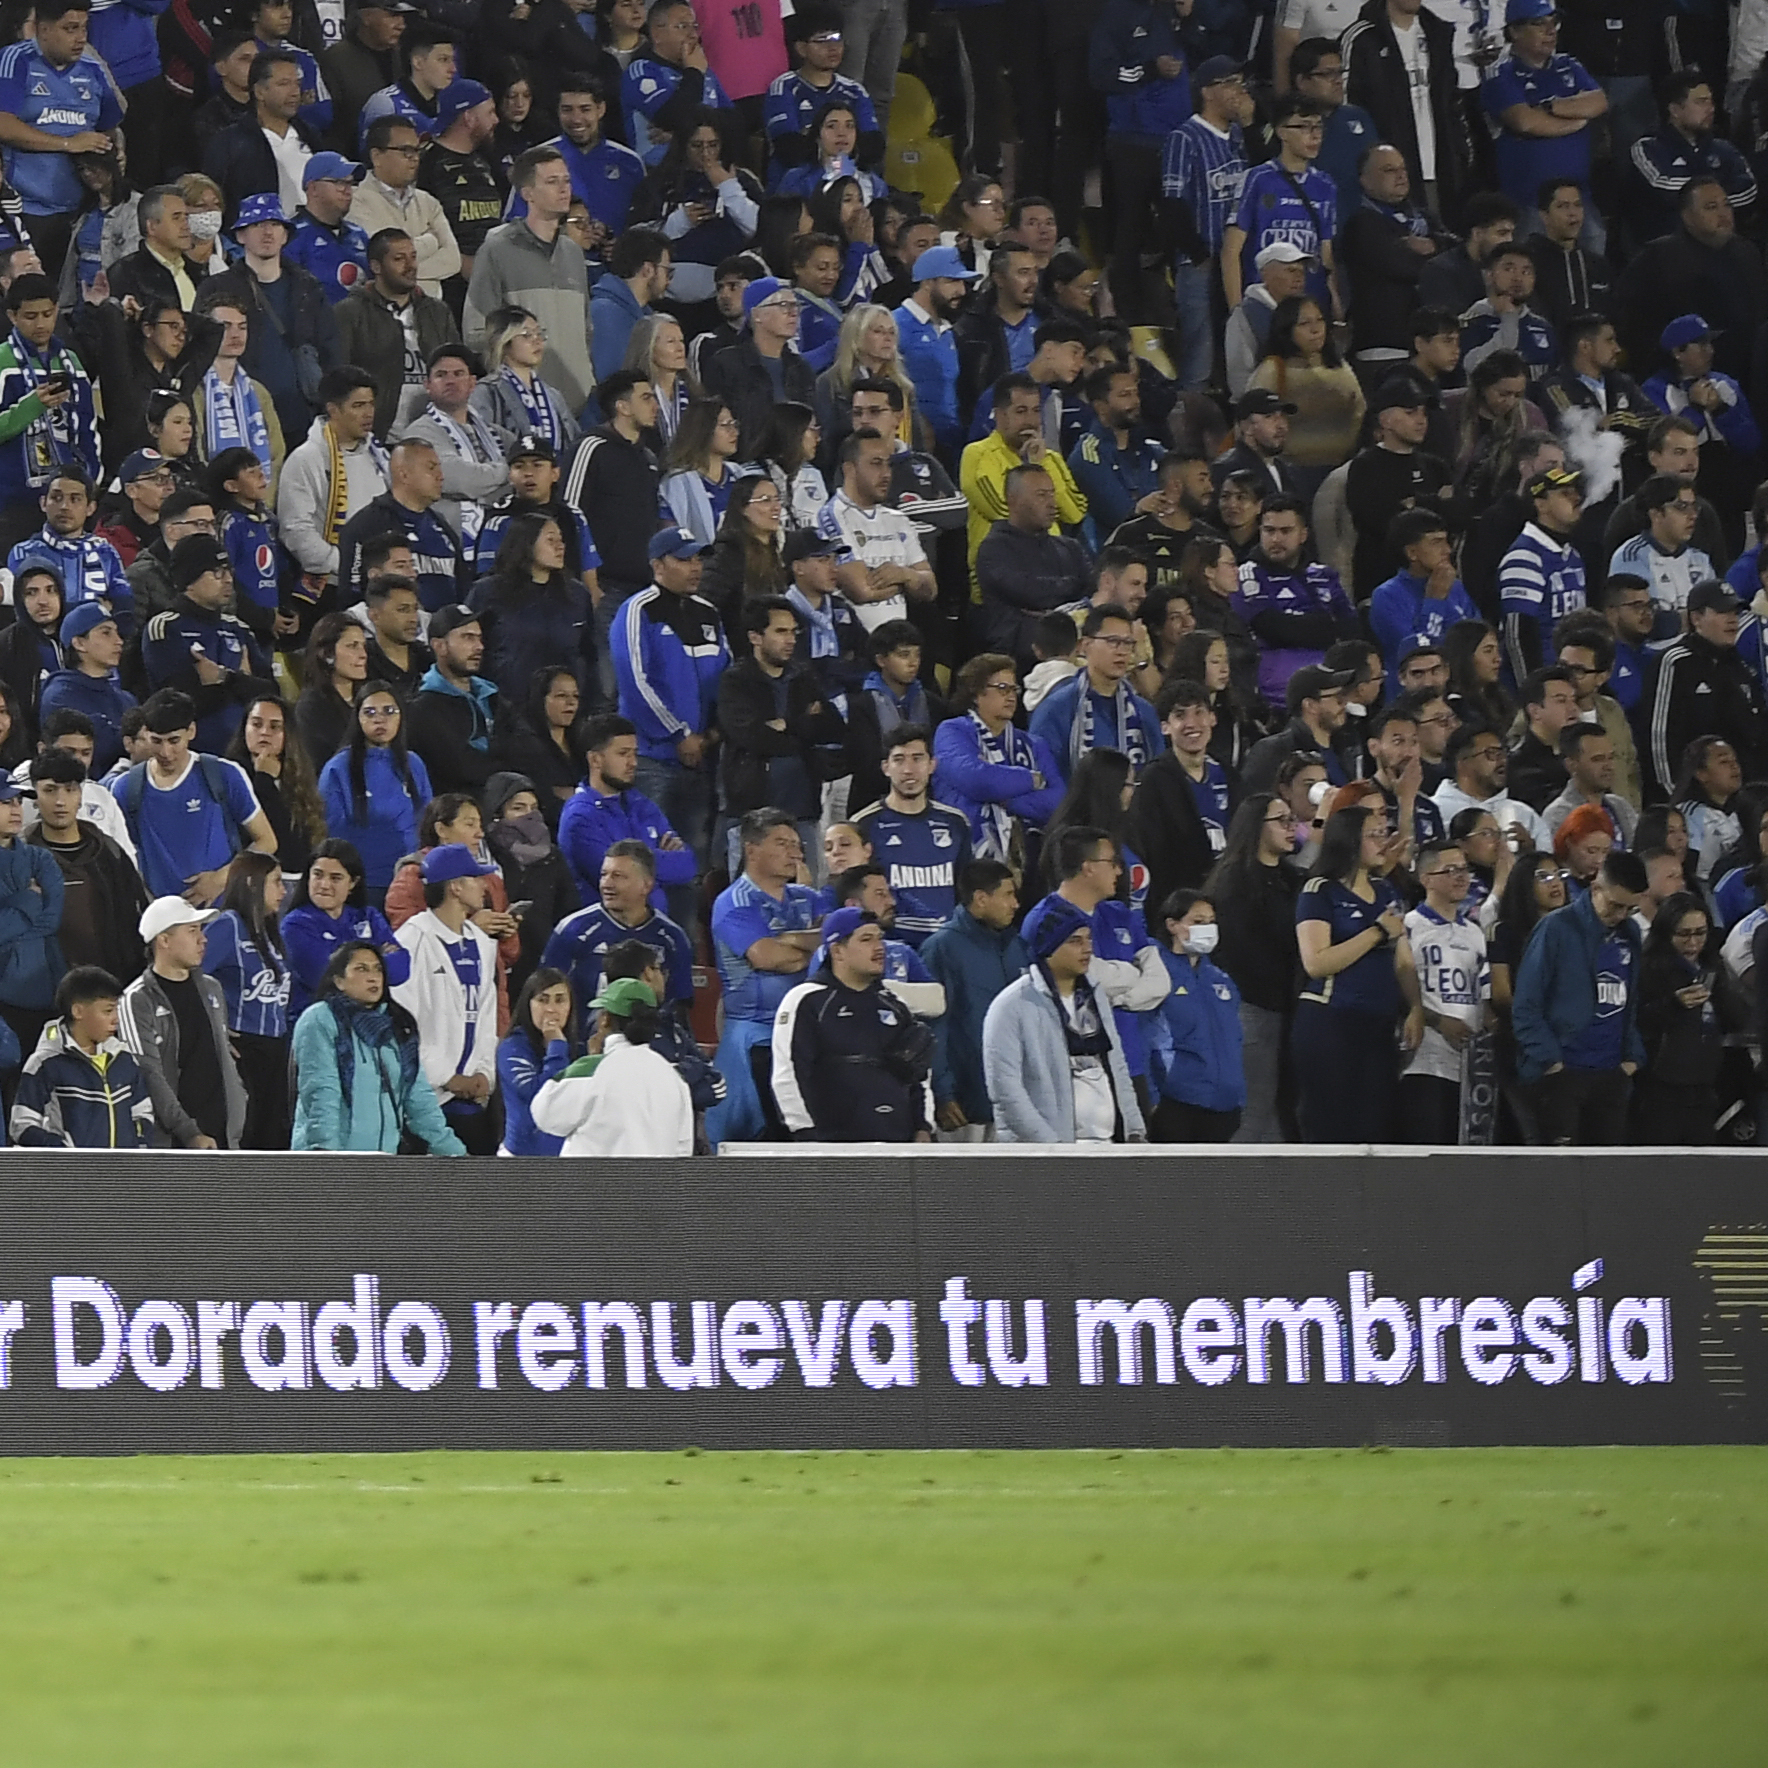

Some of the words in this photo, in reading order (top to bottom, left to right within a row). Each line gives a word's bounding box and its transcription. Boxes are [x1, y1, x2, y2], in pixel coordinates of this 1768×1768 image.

[37, 108, 86, 125] ANDINA
[890, 862, 953, 889] ANDINA
[1423, 945, 1442, 965] 10
[1598, 982, 1627, 1005] DINA
[51, 1272, 448, 1390] Dorado
[473, 1298, 916, 1389] renueva
[942, 1276, 1048, 1388] tu
[1077, 1258, 1672, 1386] membresía
